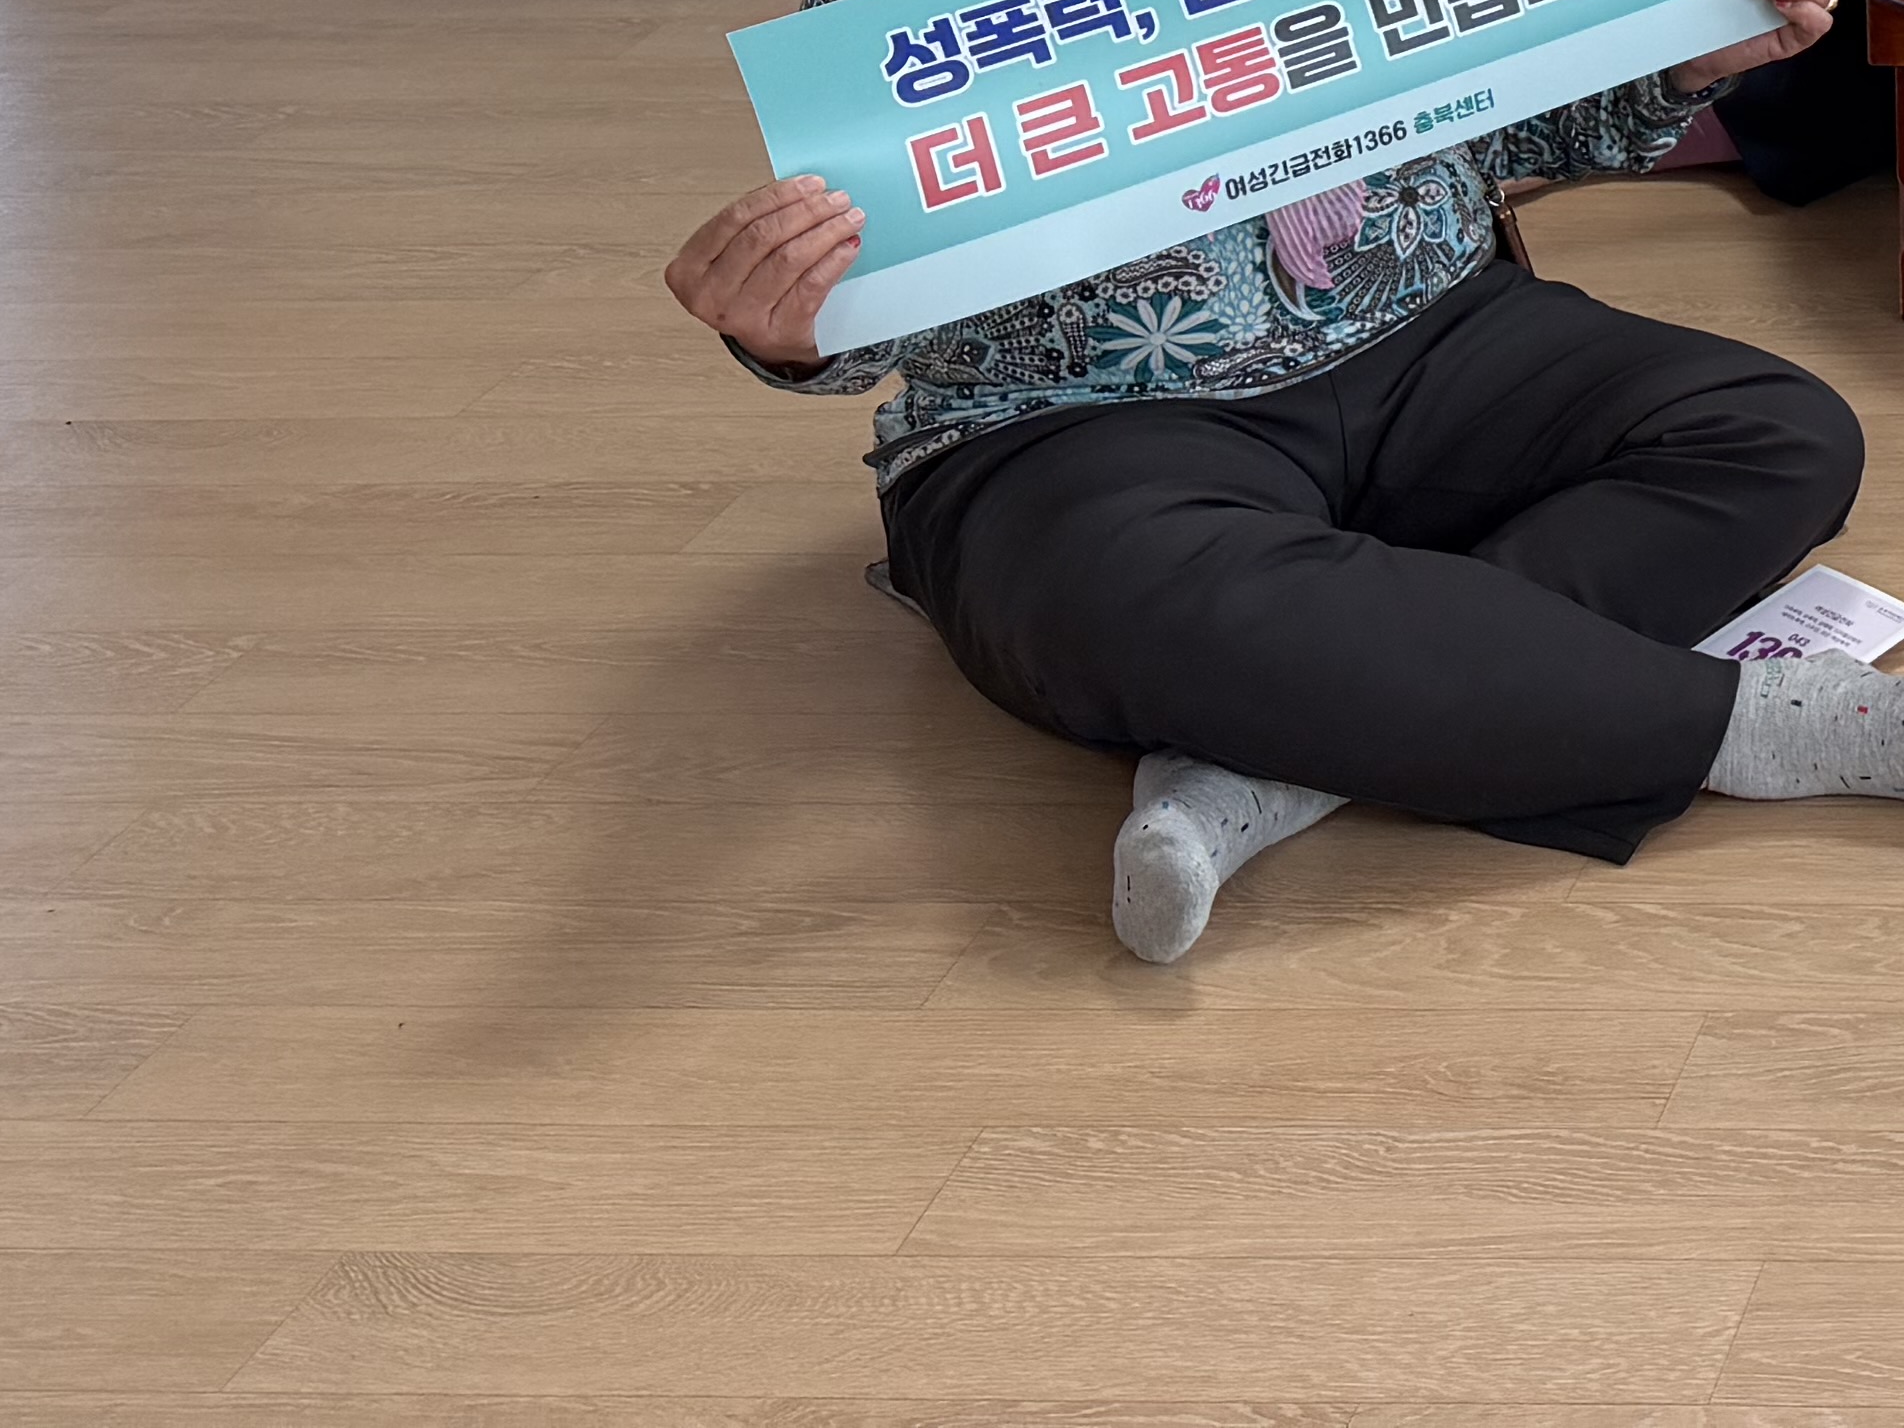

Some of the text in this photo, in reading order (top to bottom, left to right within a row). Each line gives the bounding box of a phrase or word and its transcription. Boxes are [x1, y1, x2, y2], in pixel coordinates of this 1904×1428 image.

[908, 112, 1002, 213] 더
[1020, 83, 1105, 182] 큰
[1121, 0, 1361, 148] 고통을
[1224, 85, 1496, 204] 여성긴급전화1366 충북센터
